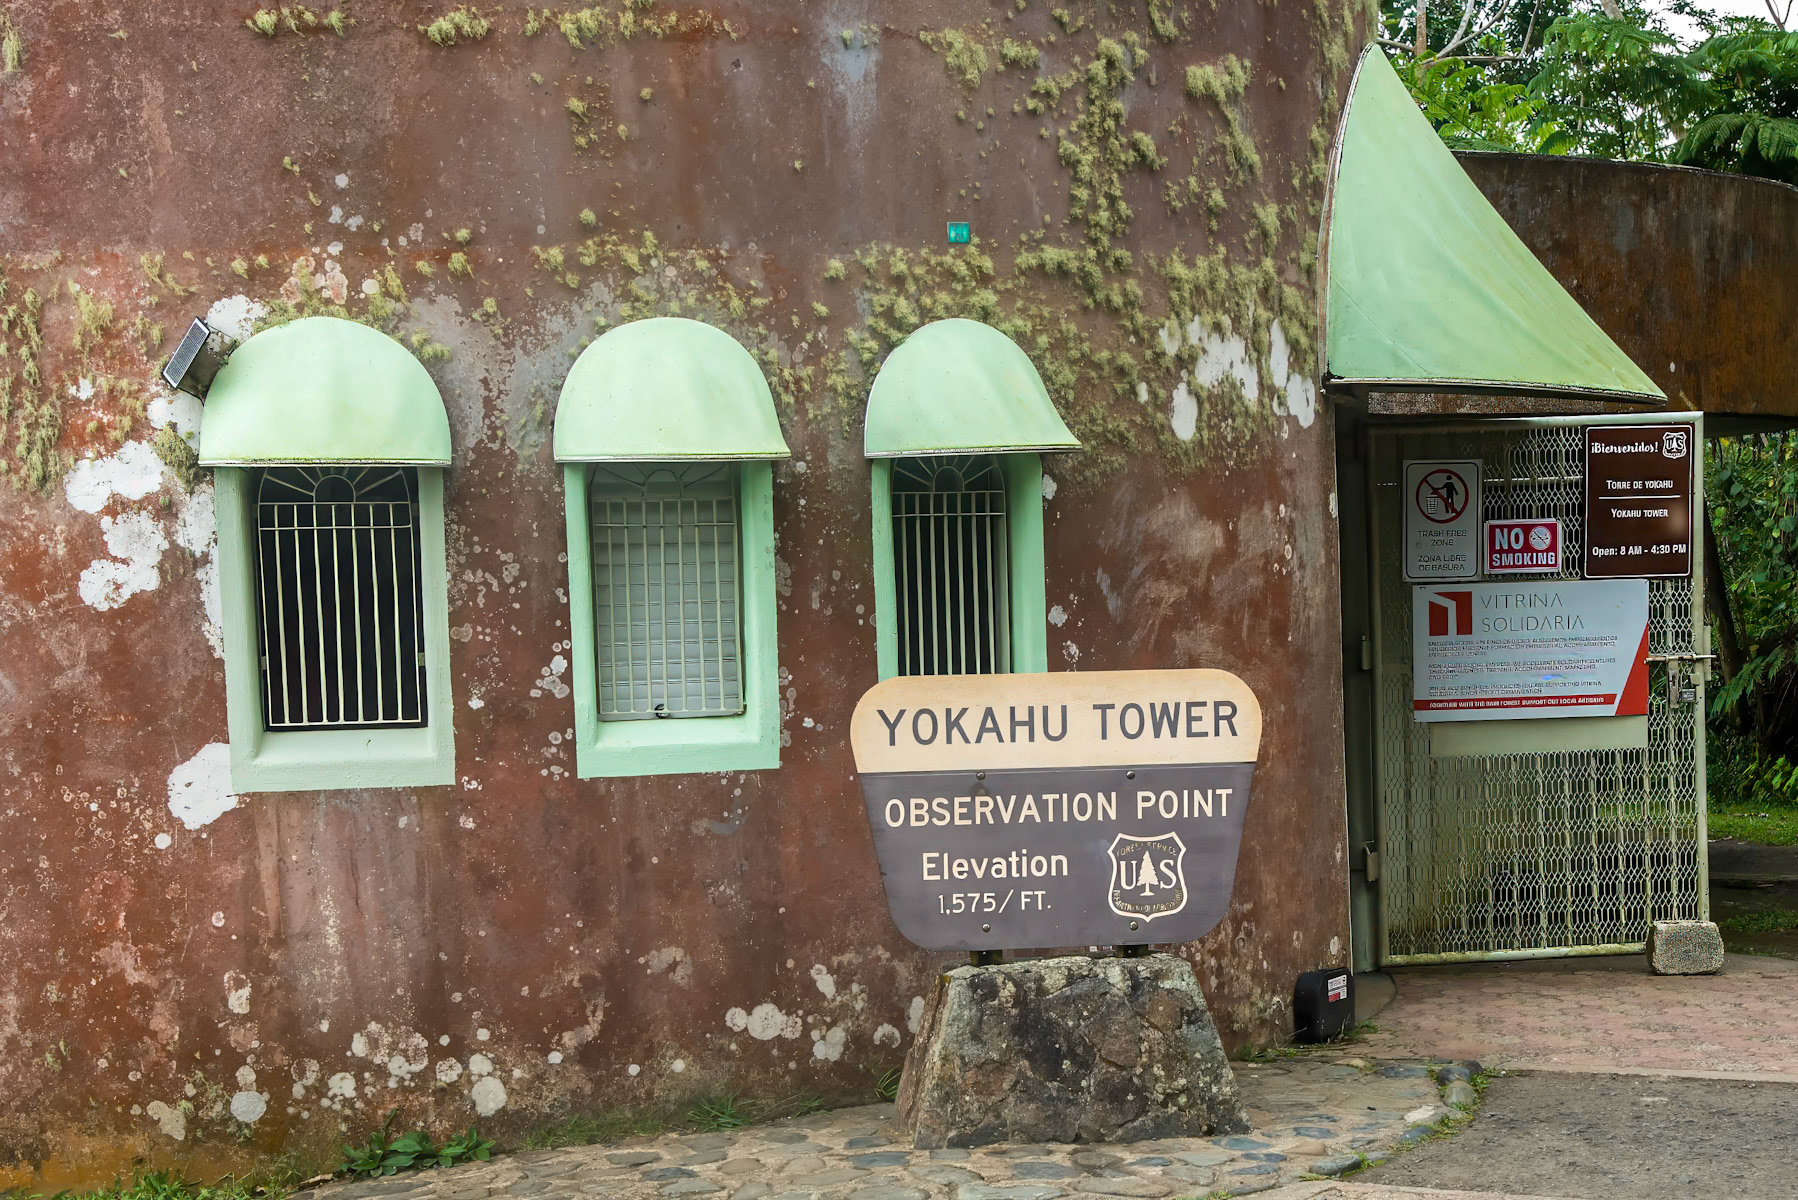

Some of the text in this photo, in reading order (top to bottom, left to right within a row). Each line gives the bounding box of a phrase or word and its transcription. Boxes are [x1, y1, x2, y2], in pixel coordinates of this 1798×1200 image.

[1606, 480, 1673, 489] TORRE DE YOKAHU
[1611, 508, 1668, 518] YOKAHU TOWER
[1495, 527, 1524, 550] NO
[1417, 554, 1467, 563] ZONA LIBRE
[1492, 552, 1556, 566] SMOKING
[1592, 546, 1618, 558] Open:
[1620, 546, 1626, 555] 8
[1628, 545, 1642, 555] AM
[1650, 544, 1671, 555] 4:30
[1672, 544, 1687, 554] PM
[1480, 593, 1563, 609] VITRINA
[1482, 615, 1585, 632] SOLIDARIA
[876, 700, 1239, 747] YOKAHU TOWER
[884, 788, 1233, 828] OBSERVATION POINT
[922, 848, 1069, 882] Elevation
[1021, 891, 1052, 911] FT.
